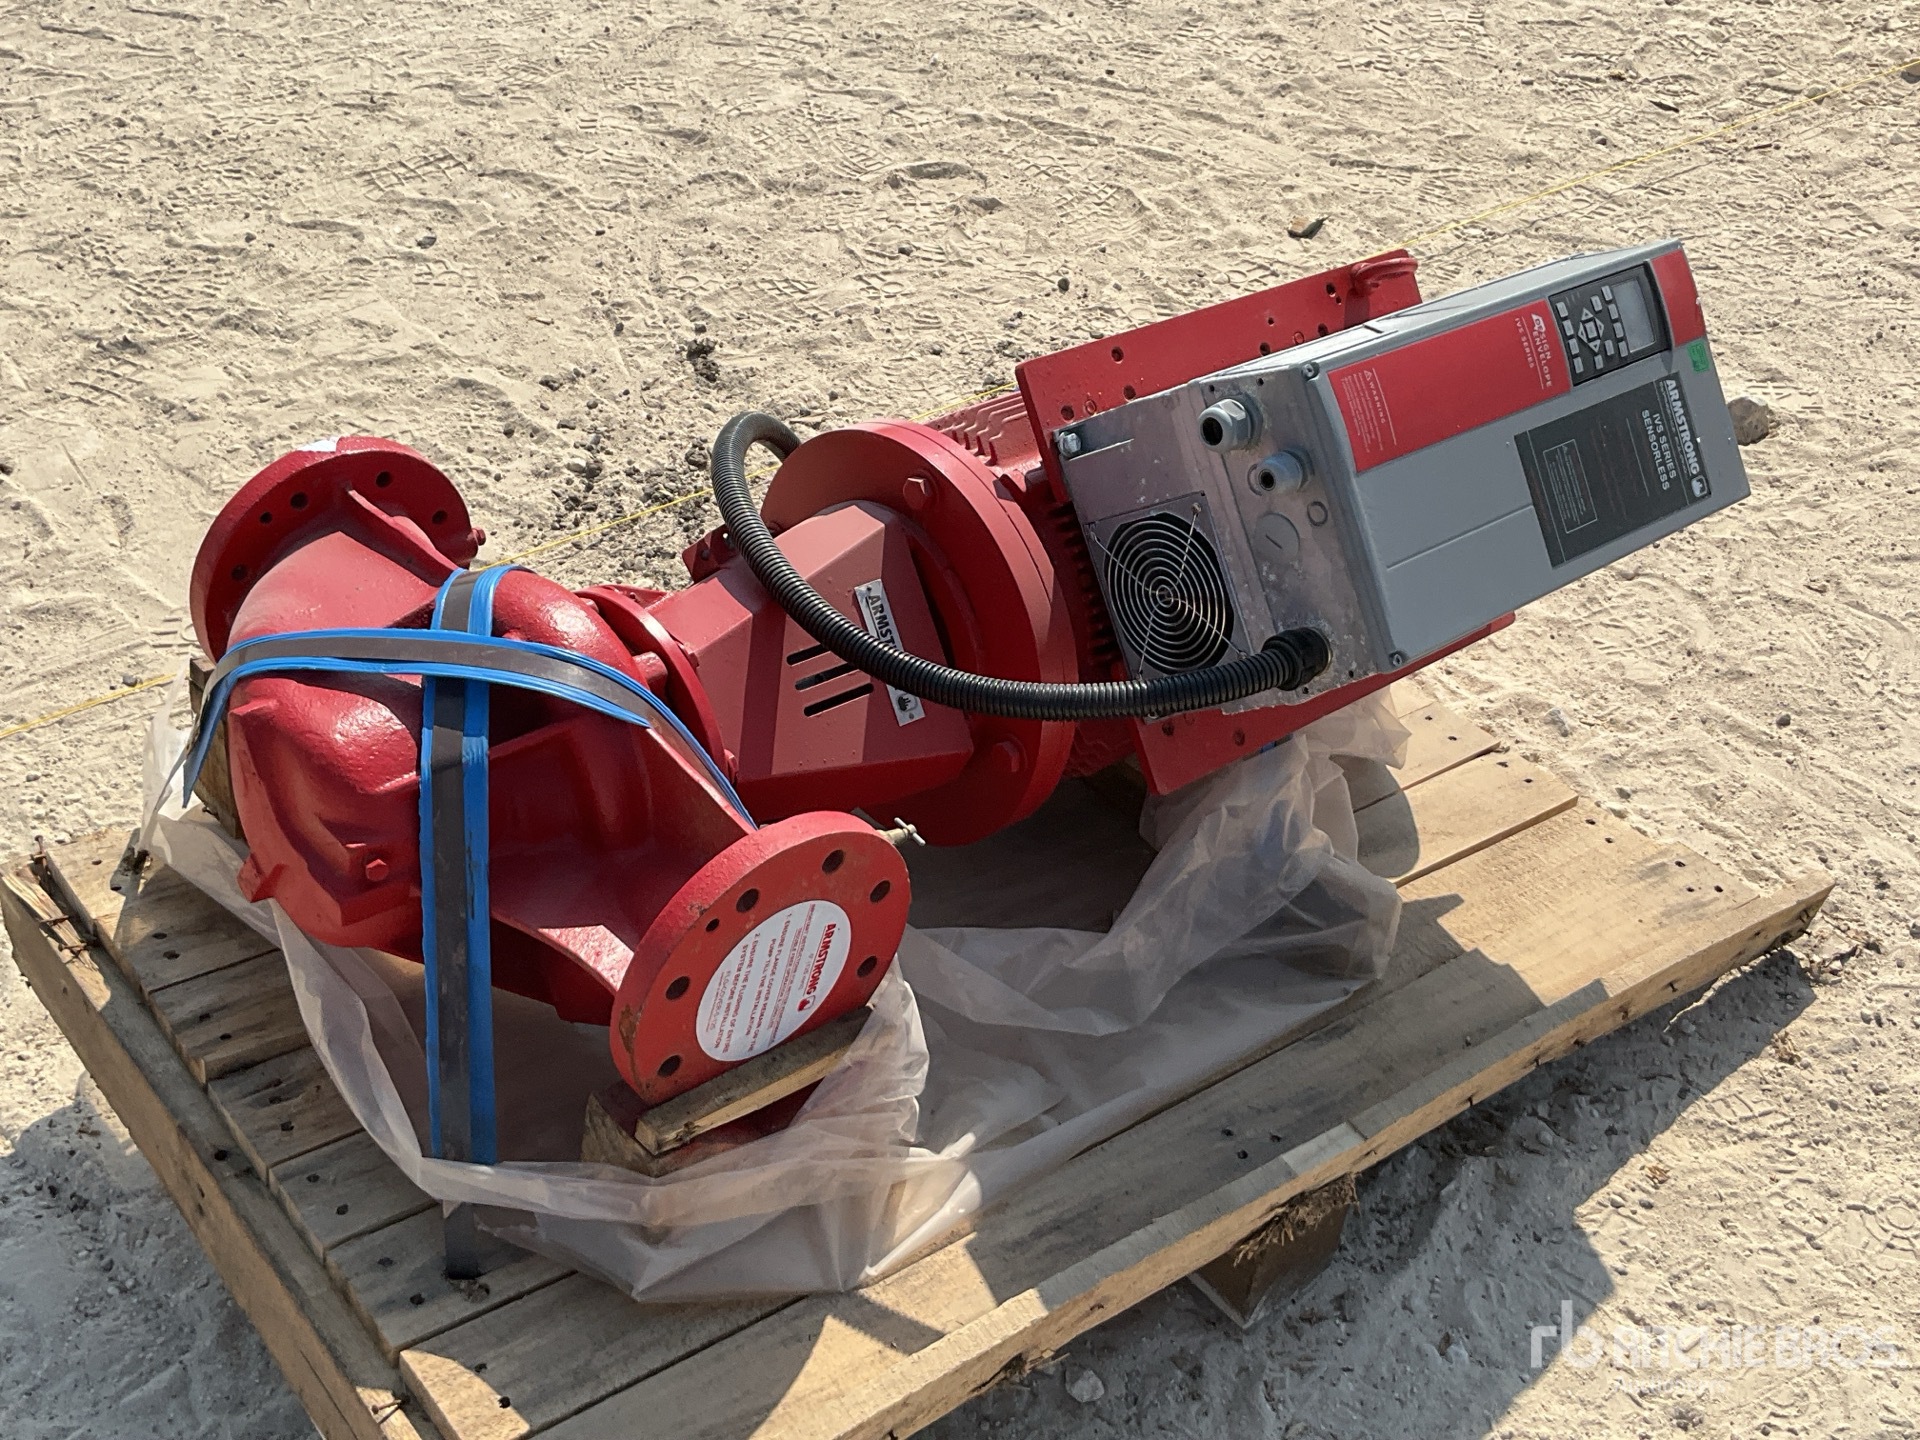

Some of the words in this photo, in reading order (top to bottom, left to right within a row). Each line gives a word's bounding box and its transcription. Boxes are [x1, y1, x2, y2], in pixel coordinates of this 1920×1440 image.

[1515, 318, 1524, 333] IVS
[1521, 336, 1534, 368] SERIES
[1533, 331, 1552, 387] ENVELOPE
[1370, 381, 1385, 423] WARNING
[1667, 380, 1700, 474] ARMSTRONG
[1642, 410, 1669, 490] SENSORLESS
[1653, 414, 1663, 433] IVS
[1660, 436, 1676, 478] SERIES
[768, 938, 776, 958] PUMP
[778, 920, 790, 948] ENSURE
[736, 944, 749, 972] SYSTEM
[747, 940, 758, 968] ENSURE
[771, 949, 782, 976] FLANGE
[807, 924, 836, 994] ARMSTRONG
[728, 974, 741, 1000] BEFORE
[742, 970, 750, 983] THE
[759, 976, 767, 988] THE
[764, 978, 774, 1001] COVER
[733, 985, 746, 1017] FLUSHING
[746, 989, 762, 1036] INSTALLATION
[714, 1001, 731, 1048] INSTALLATION
[730, 1018, 737, 1027] OF
[756, 1003, 767, 1028] REMAIN
[722, 1030, 732, 1053] ENTIRE
